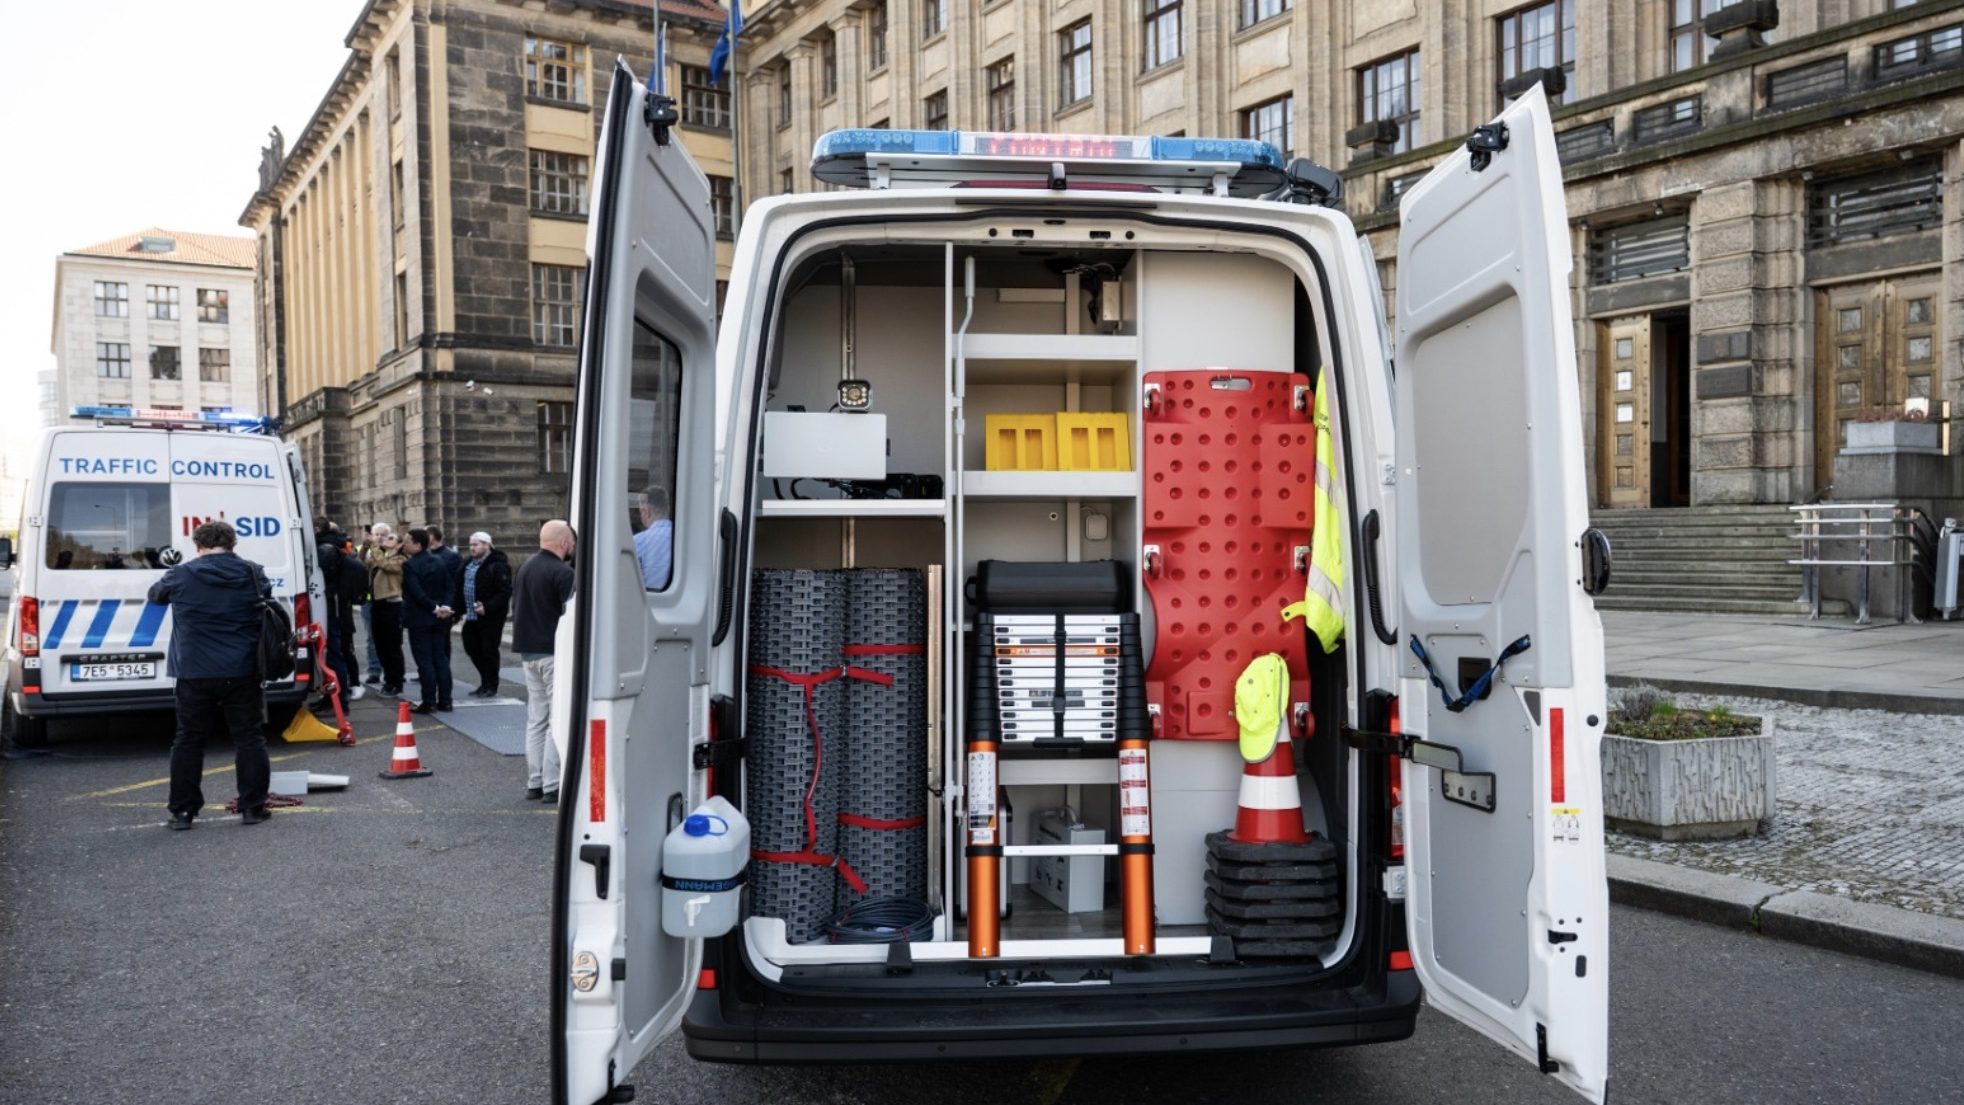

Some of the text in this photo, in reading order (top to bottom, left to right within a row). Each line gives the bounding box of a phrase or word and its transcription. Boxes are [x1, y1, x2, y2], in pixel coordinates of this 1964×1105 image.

[59, 458, 275, 479] TRAFFIC CONTROL
[83, 663, 149, 678] 7E5 5345
